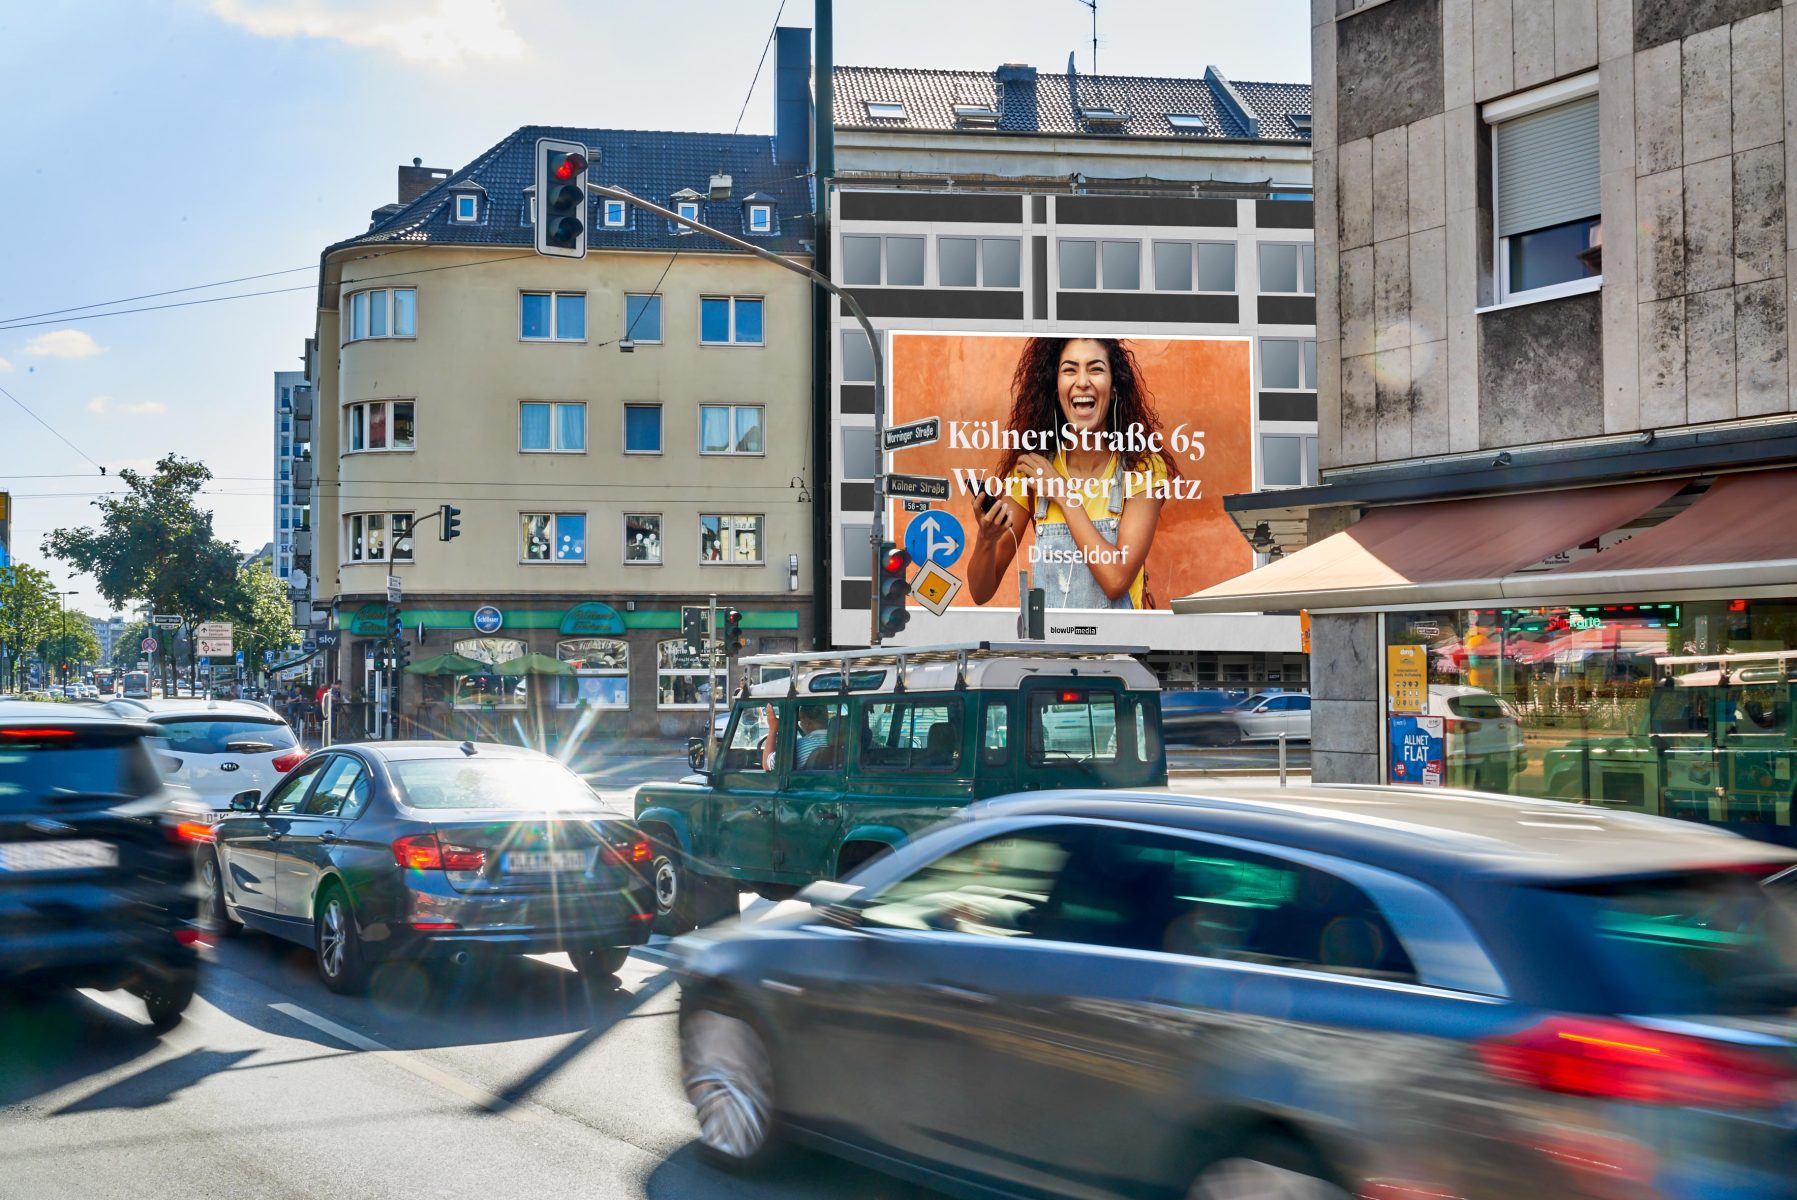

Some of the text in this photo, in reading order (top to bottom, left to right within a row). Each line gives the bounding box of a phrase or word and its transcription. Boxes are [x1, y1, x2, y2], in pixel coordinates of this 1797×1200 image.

[886, 424, 934, 445] Worringer Straße
[947, 420, 1206, 461] Kölner Straße 65
[891, 479, 945, 495] Kölner Straße
[951, 467, 1202, 508] Worringer Platz
[1028, 544, 1129, 565] Düsseldorf
[318, 635, 337, 646] sky
[1404, 734, 1429, 746] ALLNET
[1404, 745, 1429, 762] FLAT
